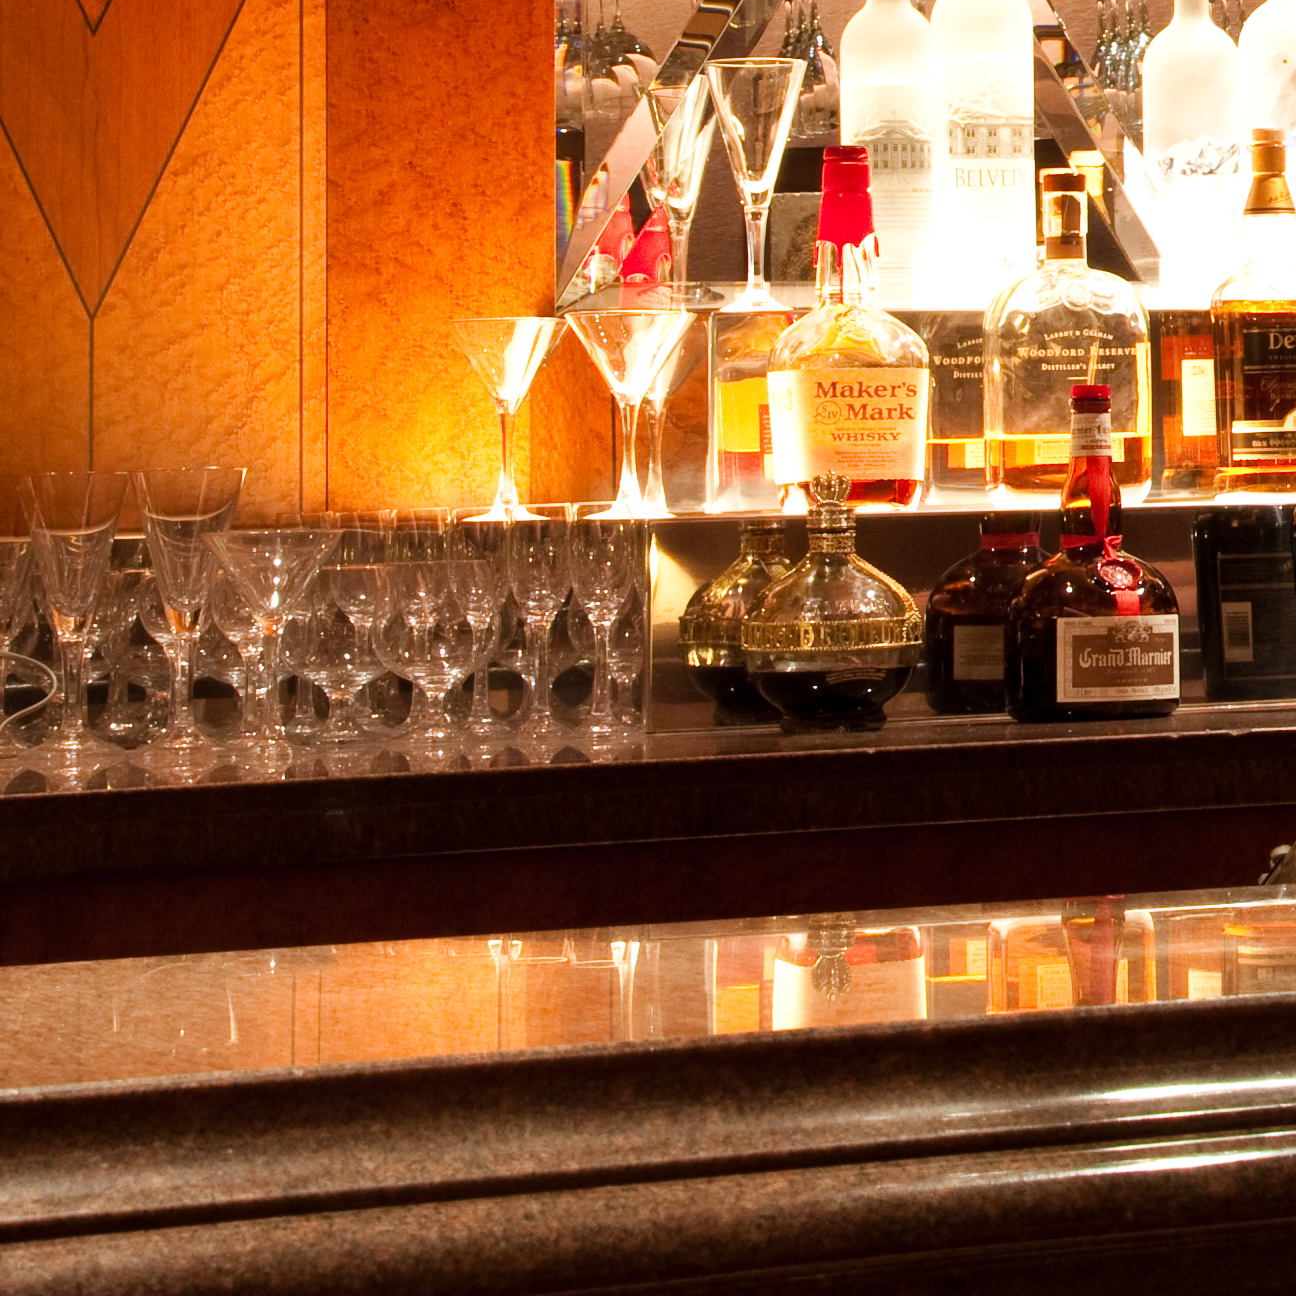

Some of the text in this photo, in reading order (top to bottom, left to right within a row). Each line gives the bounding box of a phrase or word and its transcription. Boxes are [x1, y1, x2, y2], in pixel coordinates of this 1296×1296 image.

[1017, 346, 1137, 358] WOODFORD RESERVE
[933, 356, 985, 366] WOODFO
[1090, 363, 1116, 371] ELECT
[814, 381, 917, 399] Maker's
[846, 403, 916, 421] Mark
[831, 432, 901, 442] WHISKY
[1079, 646, 1172, 668] Grand Marnier
